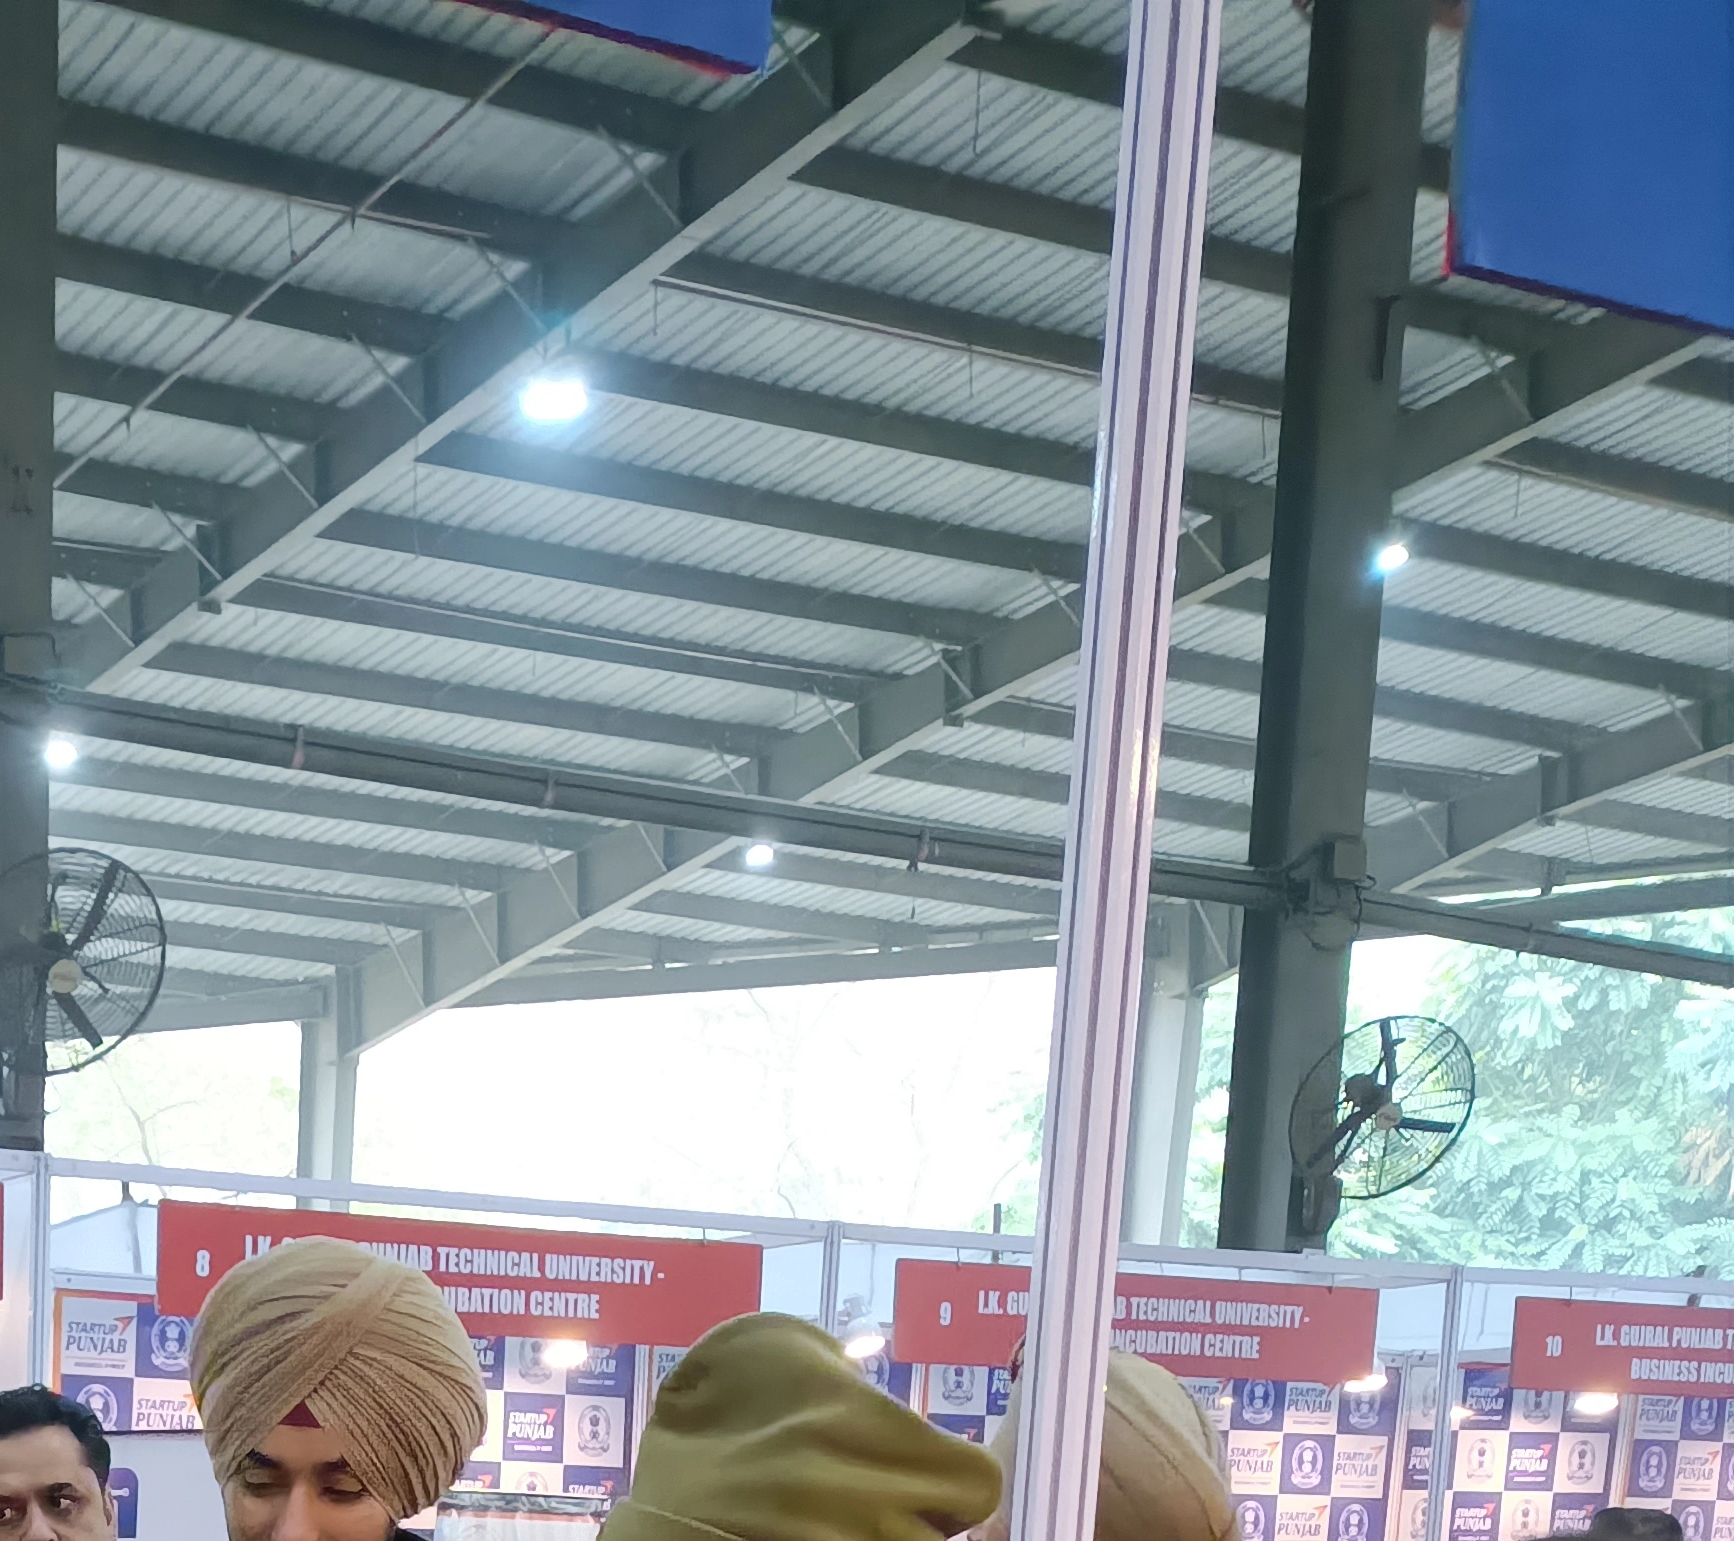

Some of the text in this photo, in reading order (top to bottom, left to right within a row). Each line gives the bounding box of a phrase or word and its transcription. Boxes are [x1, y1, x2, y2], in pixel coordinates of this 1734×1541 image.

[196, 1249, 210, 1277] 8
[437, 1246, 541, 1279] TECHNICAL
[544, 1258, 654, 1286] UNIVERSITY
[529, 1290, 600, 1319] CENTRE
[978, 1290, 1004, 1316] I.K.
[1130, 1297, 1211, 1325] TECHNICAL
[1215, 1301, 1304, 1328] UNIVERSITY
[939, 1302, 952, 1326] 9
[67, 1321, 119, 1336] STARTUP
[66, 1335, 128, 1356] PUNJAB
[1204, 1331, 1260, 1359] CENTRE
[1620, 1325, 1670, 1348] GUJRAL
[1672, 1327, 1724, 1350] PUNJAB
[1545, 1335, 1563, 1357] 10
[1630, 1357, 1699, 1383] BUSINESS
[1289, 1386, 1327, 1398] STARTUP
[136, 1398, 188, 1412] STARTUP
[1286, 1398, 1332, 1416] PUNJAB
[1465, 1396, 1504, 1412] PUNJAB
[135, 1412, 196, 1429] PUNJAB
[509, 1411, 548, 1425] STARTUP
[1639, 1408, 1678, 1424] PUNJAB
[507, 1421, 554, 1440] PUNJAB
[1230, 1446, 1268, 1459] STARTUP
[1337, 1451, 1373, 1463] STARTUP
[1512, 1448, 1544, 1459] STARTUP
[1229, 1459, 1274, 1476] PUNJAB
[1335, 1462, 1378, 1478] PUNJAB
[1509, 1459, 1548, 1473] PUNJAB
[1676, 1467, 1714, 1481] PUNJAB
[1278, 1511, 1316, 1522] STARTUP
[1455, 1507, 1488, 1518] STARTUP
[1555, 1508, 1587, 1519] STARTUP
[1277, 1522, 1322, 1539] PUNJAB
[1453, 1517, 1492, 1532] PUNJAB
[1553, 1518, 1592, 1532] PUNJAB
